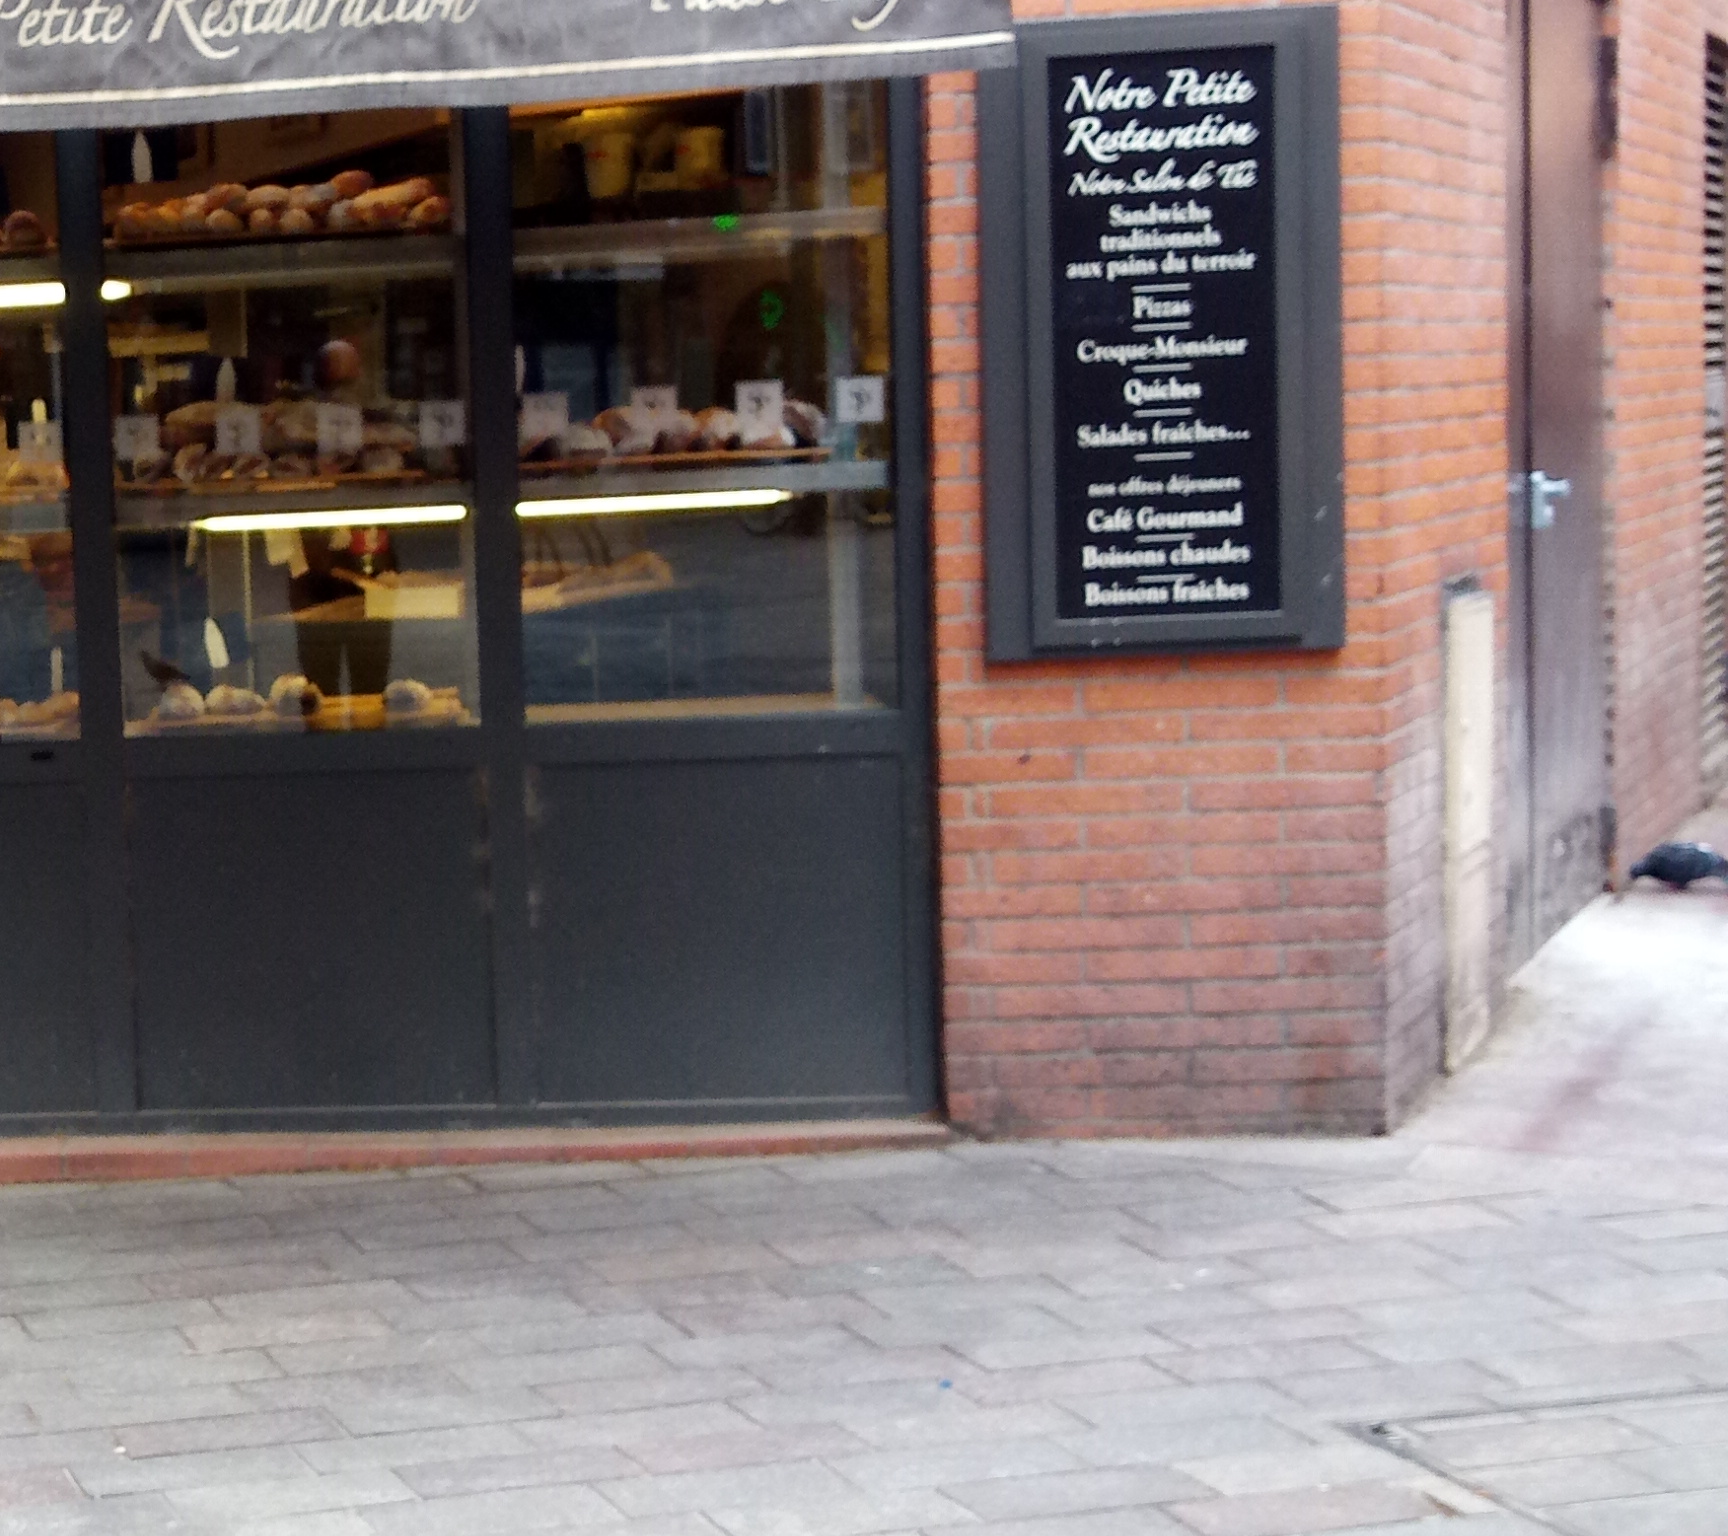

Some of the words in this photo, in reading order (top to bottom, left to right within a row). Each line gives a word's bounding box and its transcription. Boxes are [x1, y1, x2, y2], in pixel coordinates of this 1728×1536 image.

[1063, 67, 1157, 113] Notre
[1161, 66, 1257, 107] Petite
[1062, 113, 1260, 163] Restauration
[1065, 262, 1104, 280] aux
[1106, 254, 1158, 282] pains
[1132, 295, 1194, 319] Pizzas
[1076, 335, 1249, 366] Croque-Monsieur
[1123, 376, 1203, 406] Quiches
[1076, 423, 1148, 449] Salades
[1086, 506, 1134, 533] Café
[1136, 500, 1244, 531] Gourmand
[1081, 544, 1167, 570] Boissons
[1170, 538, 1251, 566] chaudes
[1083, 581, 1170, 607] Boissons
